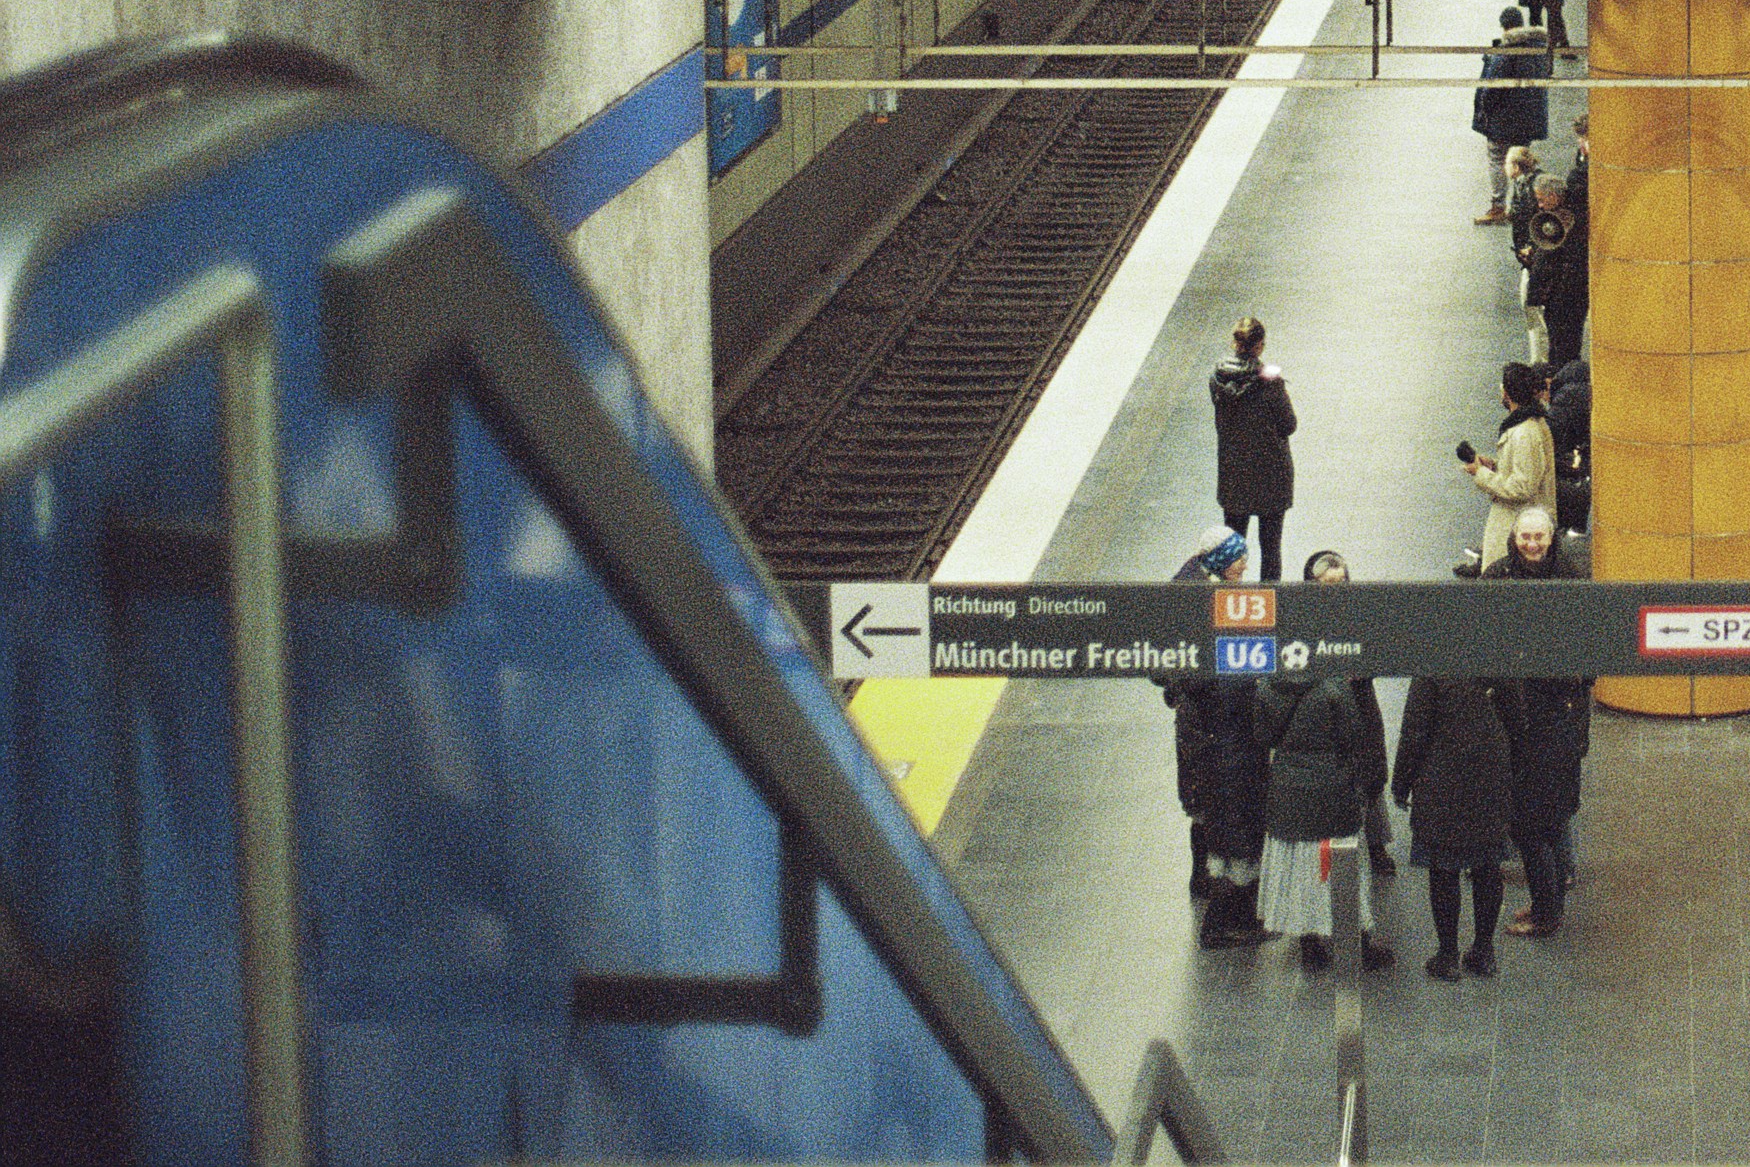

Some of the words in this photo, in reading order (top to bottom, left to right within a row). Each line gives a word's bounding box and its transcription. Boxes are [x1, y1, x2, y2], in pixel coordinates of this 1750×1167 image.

[933, 595, 1016, 618] Richtung
[1029, 596, 1107, 615] Direction
[1226, 594, 1267, 621] U3
[934, 640, 1078, 669] Münchner
[1088, 640, 1200, 669] Freiheit
[1226, 641, 1268, 669] U6
[1315, 640, 1362, 656] Arena
